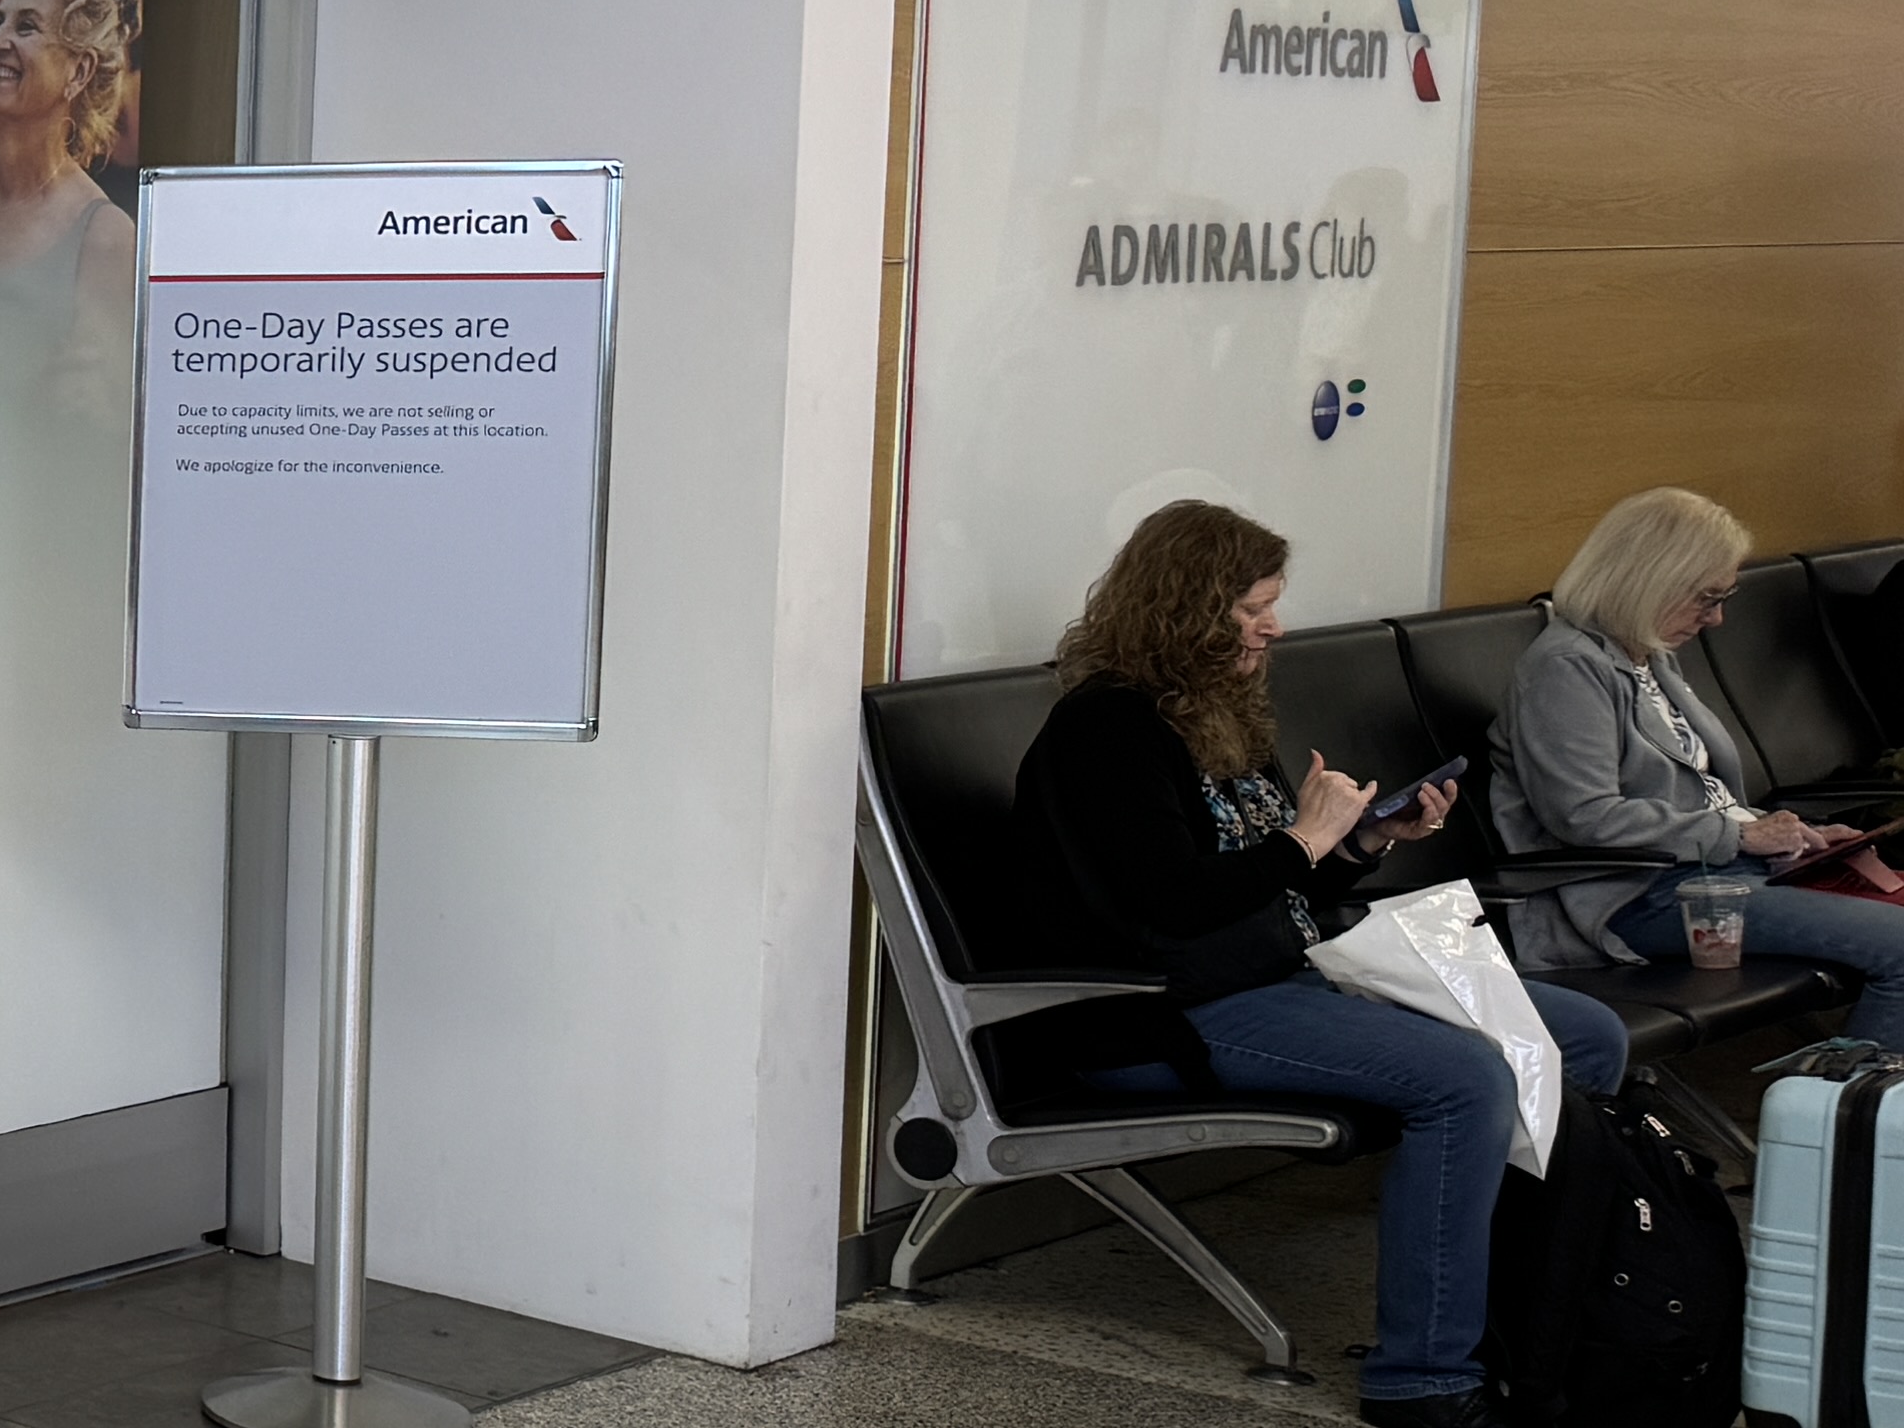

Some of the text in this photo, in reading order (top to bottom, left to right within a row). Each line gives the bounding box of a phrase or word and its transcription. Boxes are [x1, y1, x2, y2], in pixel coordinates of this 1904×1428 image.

[1219, 7, 1389, 80] American
[377, 208, 528, 236] American
[1075, 217, 1376, 288] ADMIRALS Club
[174, 311, 510, 346] One-Day Passes are
[171, 343, 557, 380] temporarily suspended
[178, 403, 495, 421] Due to capacity limits, we are not selling or
[176, 422, 549, 439] accepting unused One-Day Passes at this location.
[175, 459, 444, 475] We apologize for the inconvenience.
